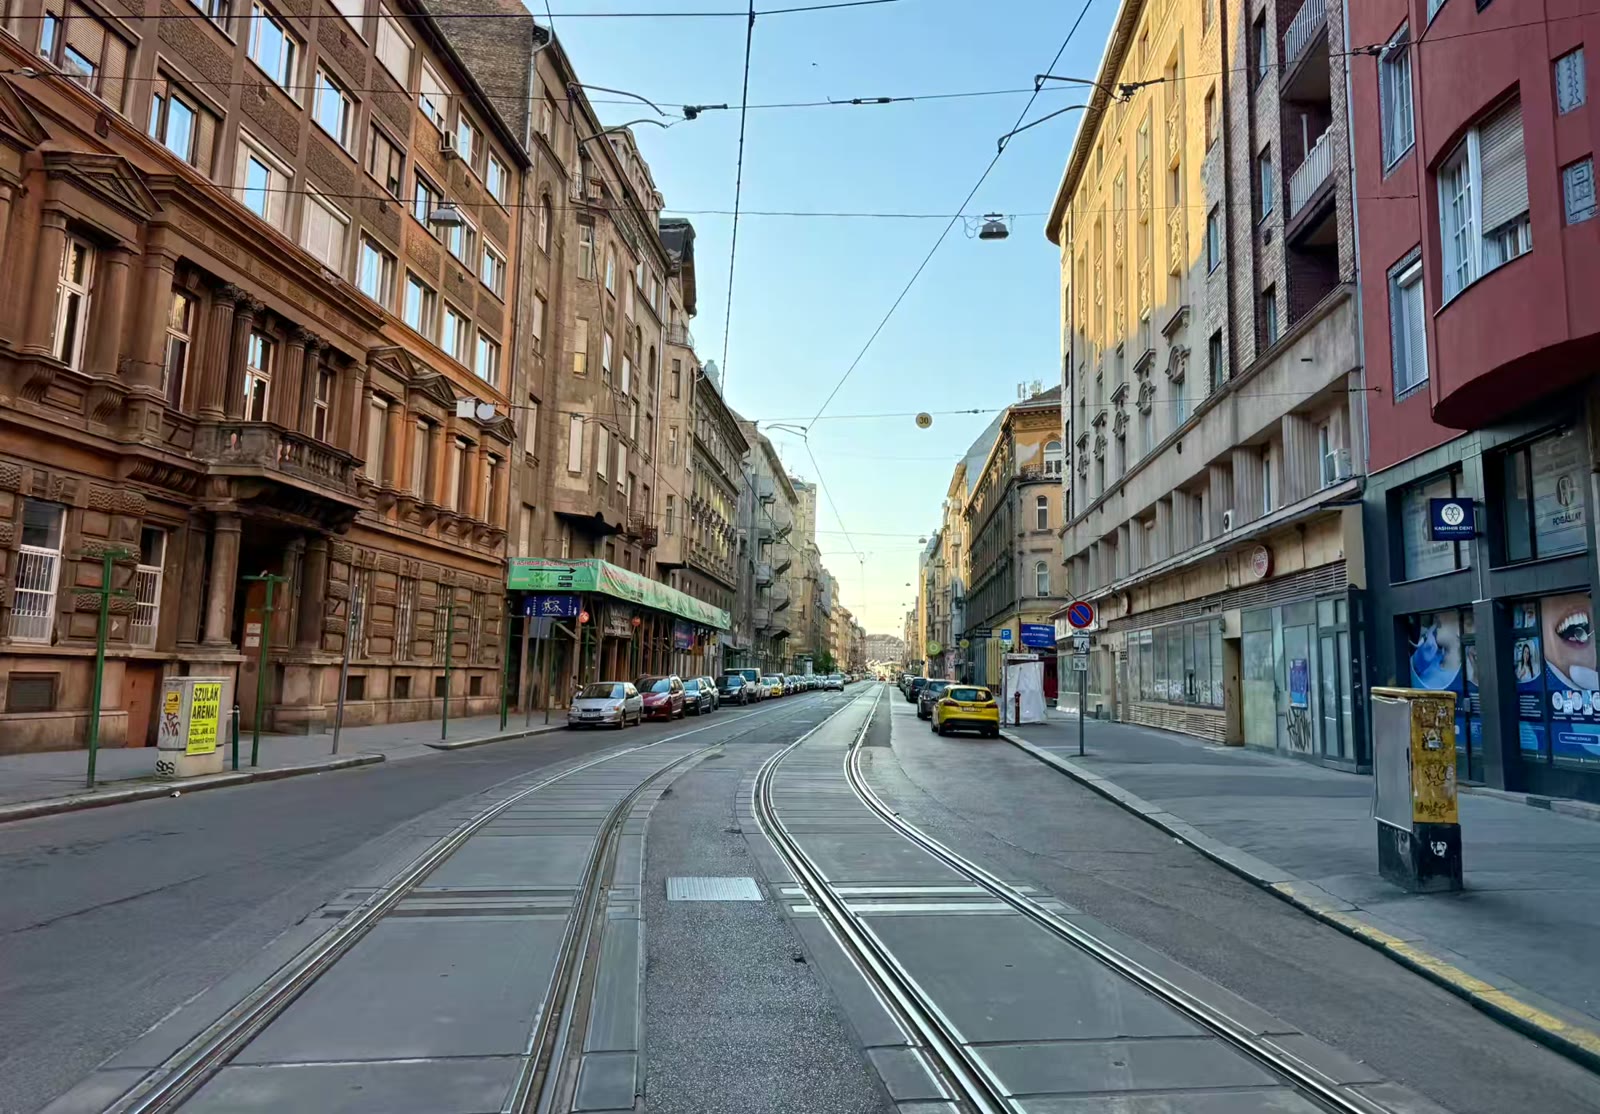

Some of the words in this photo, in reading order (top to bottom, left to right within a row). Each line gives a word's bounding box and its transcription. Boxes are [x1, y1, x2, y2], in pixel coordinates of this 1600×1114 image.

[919, 416, 929, 425] 30
[194, 686, 219, 701] SZULÁK
[192, 703, 217, 719] ARÉNA!
